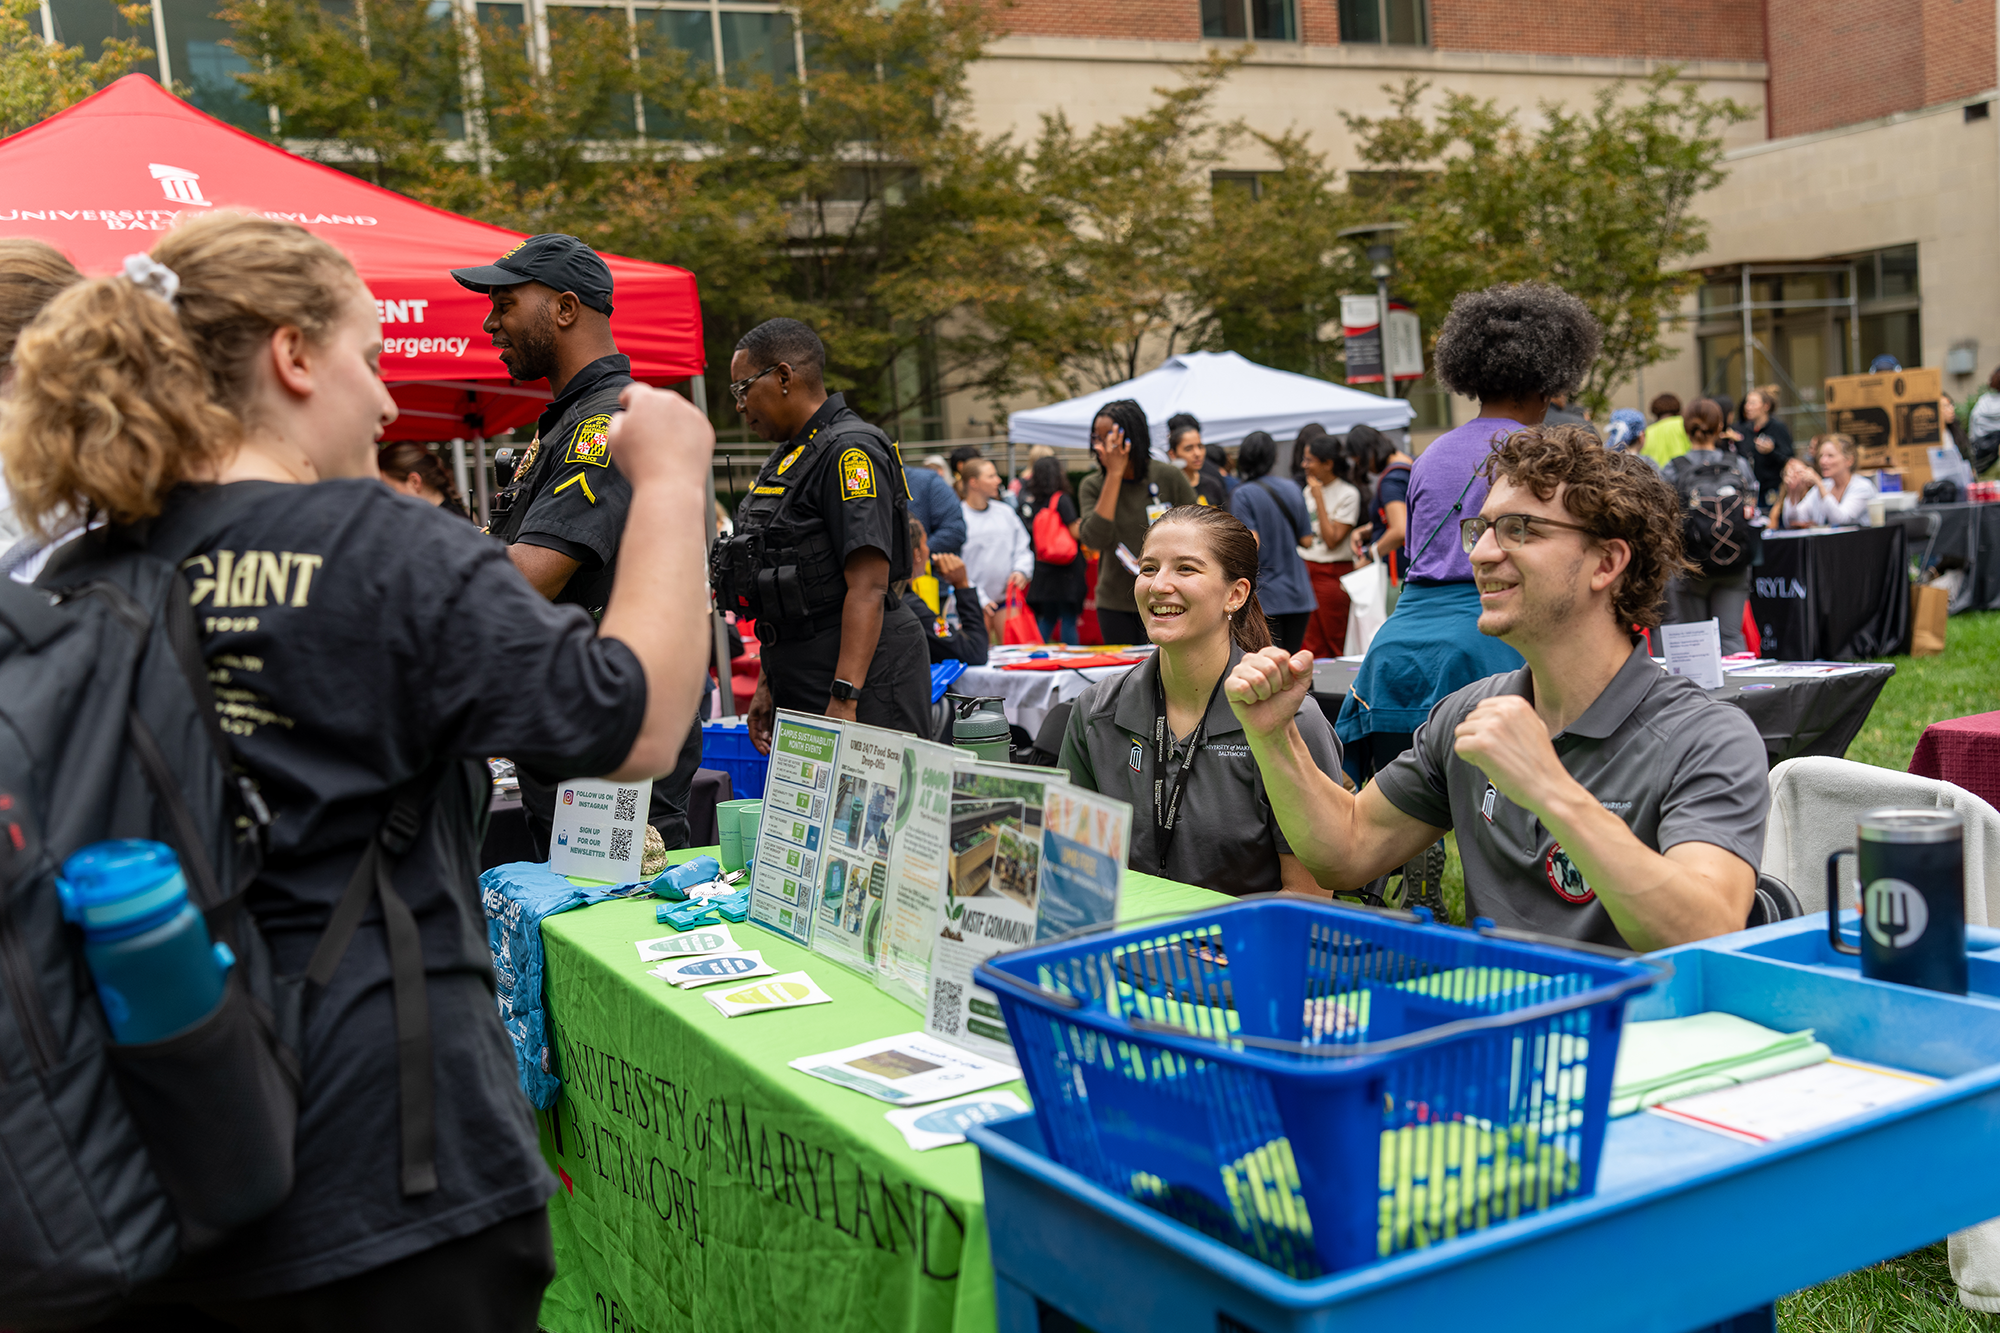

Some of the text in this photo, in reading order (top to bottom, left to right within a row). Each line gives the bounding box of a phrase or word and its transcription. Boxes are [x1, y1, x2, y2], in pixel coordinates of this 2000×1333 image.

[383, 336, 471, 358] ergency
[576, 454, 598, 462] POLICE
[180, 550, 322, 608] GIANT
[206, 617, 259, 632] TOUR
[780, 728, 835, 748] CAMPUS SUSTAINABILITY
[788, 740, 822, 755] MONTH EVENTS
[850, 739, 863, 752] UMB
[862, 742, 874, 755] 24/7
[873, 745, 887, 758] Food
[861, 755, 886, 771] Drop-Offs
[576, 790, 598, 800] FOLLOW
[597, 793, 606, 801] US
[918, 788, 933, 810] AT
[578, 800, 609, 811] INSTAGRAM
[579, 826, 601, 836] SIGN UP
[577, 837, 601, 847] FOR OUR
[570, 846, 606, 859] NEWSLETTER
[961, 908, 986, 935] MSTF
[552, 1019, 966, 1281] UNIVERSITY of MARYLAND
[566, 1094, 706, 1249] BALTIMORE
